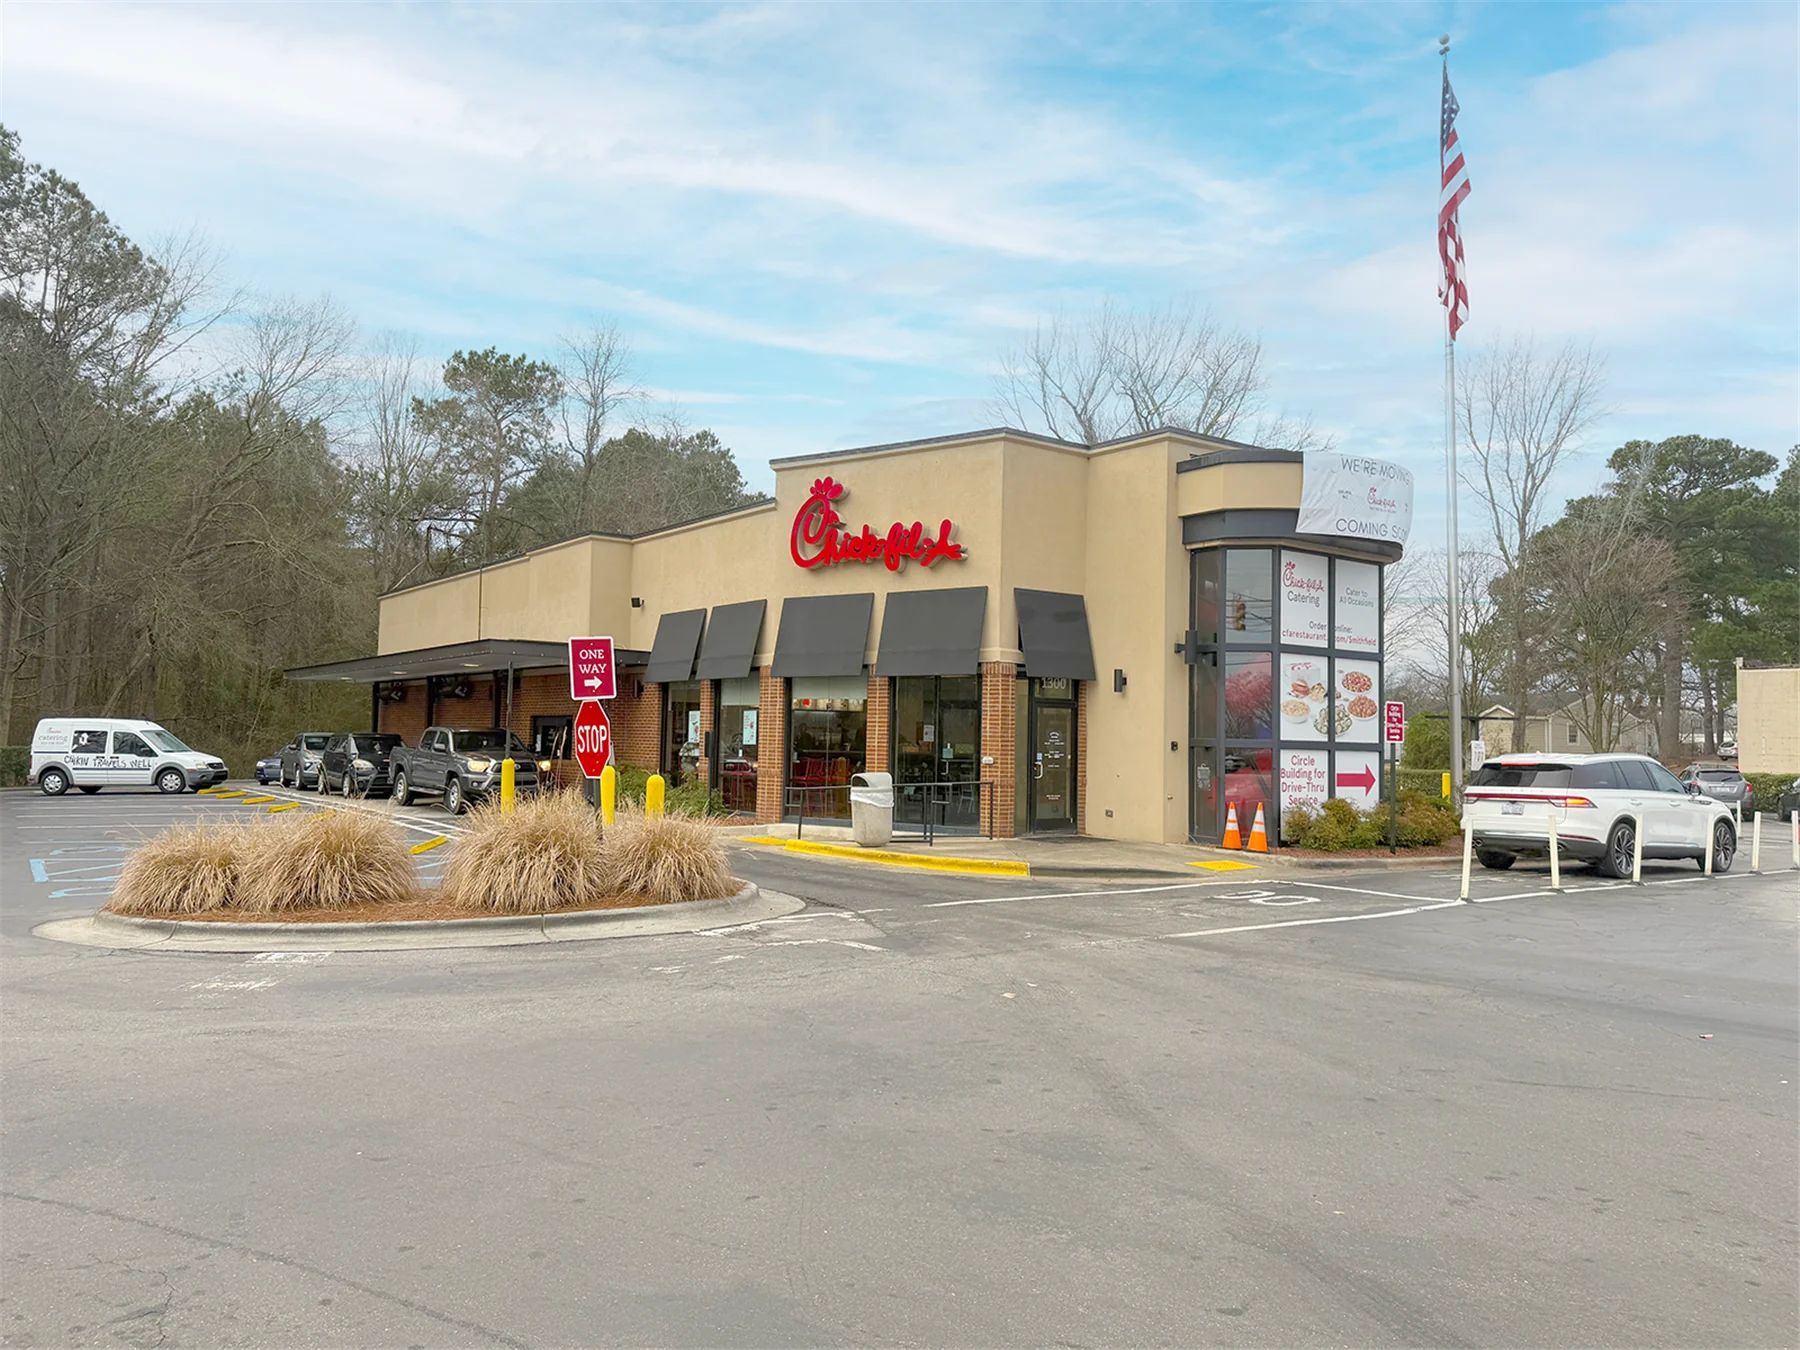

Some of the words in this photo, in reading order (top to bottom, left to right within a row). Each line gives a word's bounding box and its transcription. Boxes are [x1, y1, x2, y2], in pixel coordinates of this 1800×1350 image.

[1341, 458, 1377, 476] WE'RE
[790, 476, 967, 573] Chick-fil-A
[1336, 518, 1388, 537] COMING
[1345, 587, 1360, 597] Cater
[1361, 590, 1368, 598] to
[1287, 590, 1320, 608] Catering
[1347, 597, 1374, 608] Occasions
[1308, 620, 1327, 630] Order
[579, 649, 605, 660] ONE
[578, 663, 607, 674] WAY
[1041, 677, 1067, 690] 1300
[577, 725, 608, 753] STOP
[129, 759, 152, 768] WELL
[1291, 755, 1315, 766] Circle
[1280, 768, 1312, 781] Building
[1314, 768, 1326, 779] for
[1281, 781, 1324, 792] Drive-Thru
[1288, 794, 1318, 806] Service
